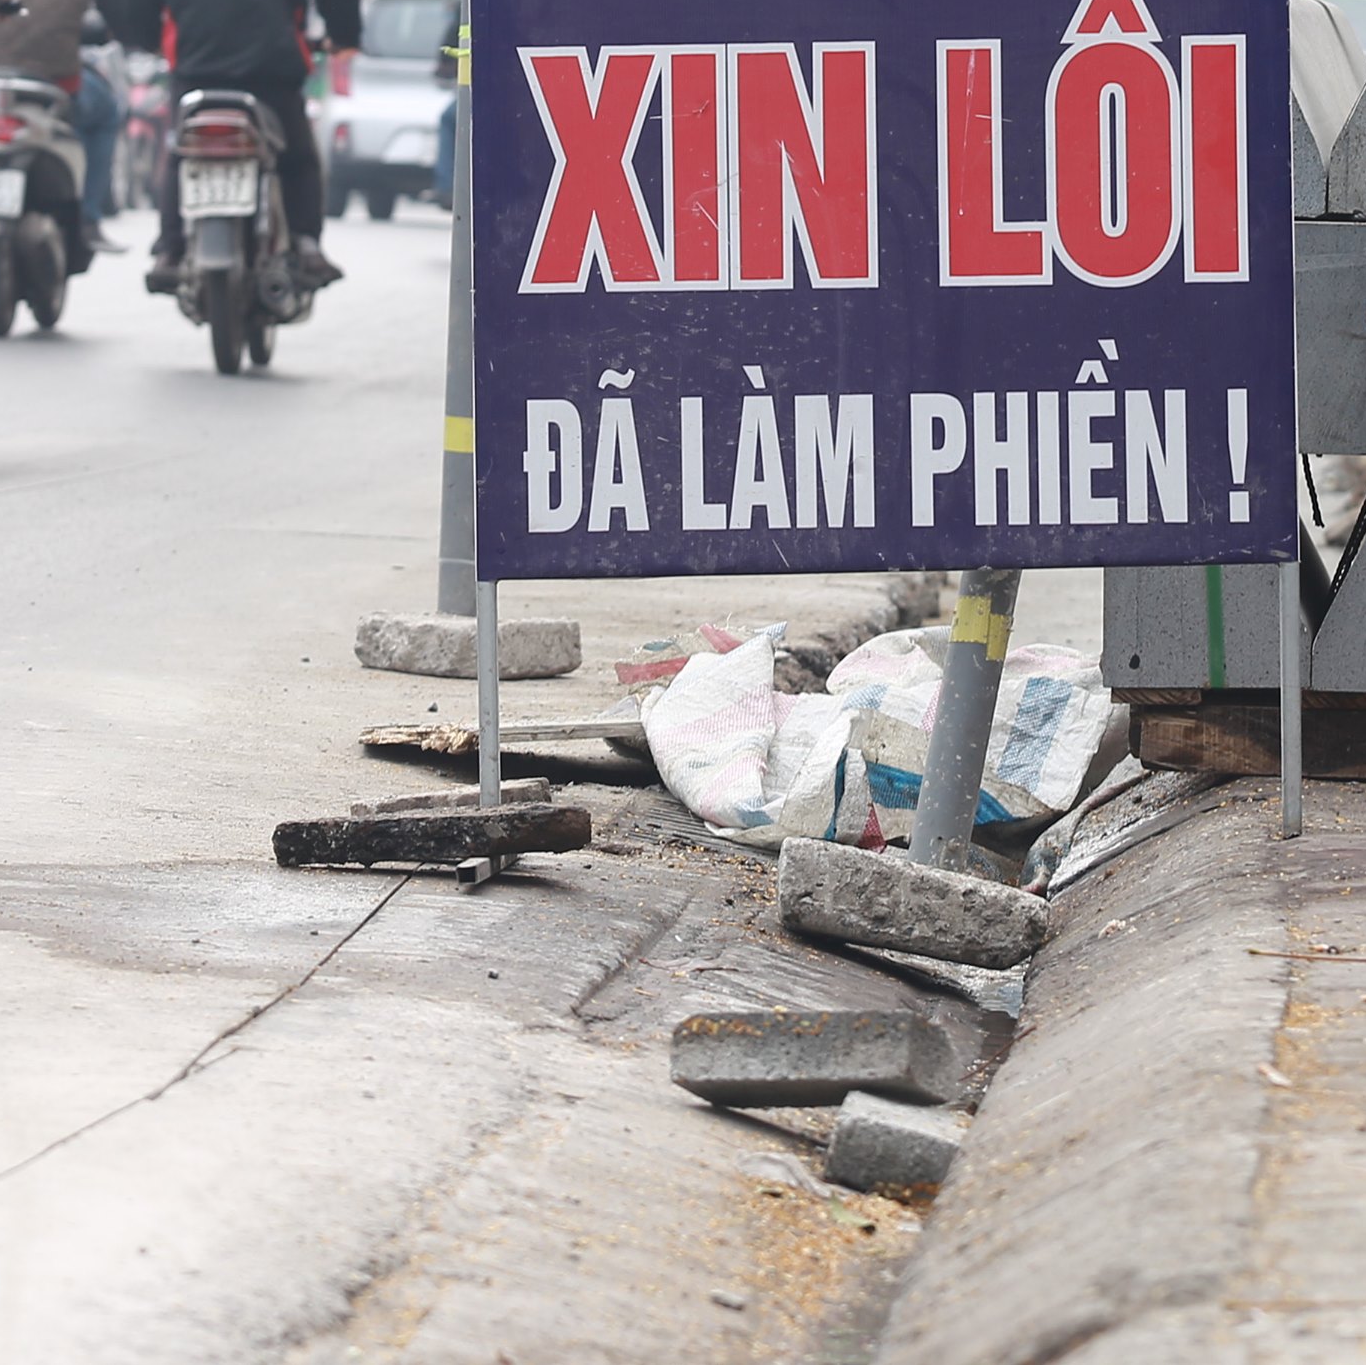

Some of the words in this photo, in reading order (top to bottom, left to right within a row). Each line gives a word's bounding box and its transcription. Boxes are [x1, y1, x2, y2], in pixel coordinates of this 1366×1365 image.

[517, 40, 880, 294] XIN
[523, 367, 650, 534] ĐÃ
[680, 365, 876, 531] LÀM
[909, 338, 1188, 529] PHIỀN
[1227, 387, 1250, 525] !
